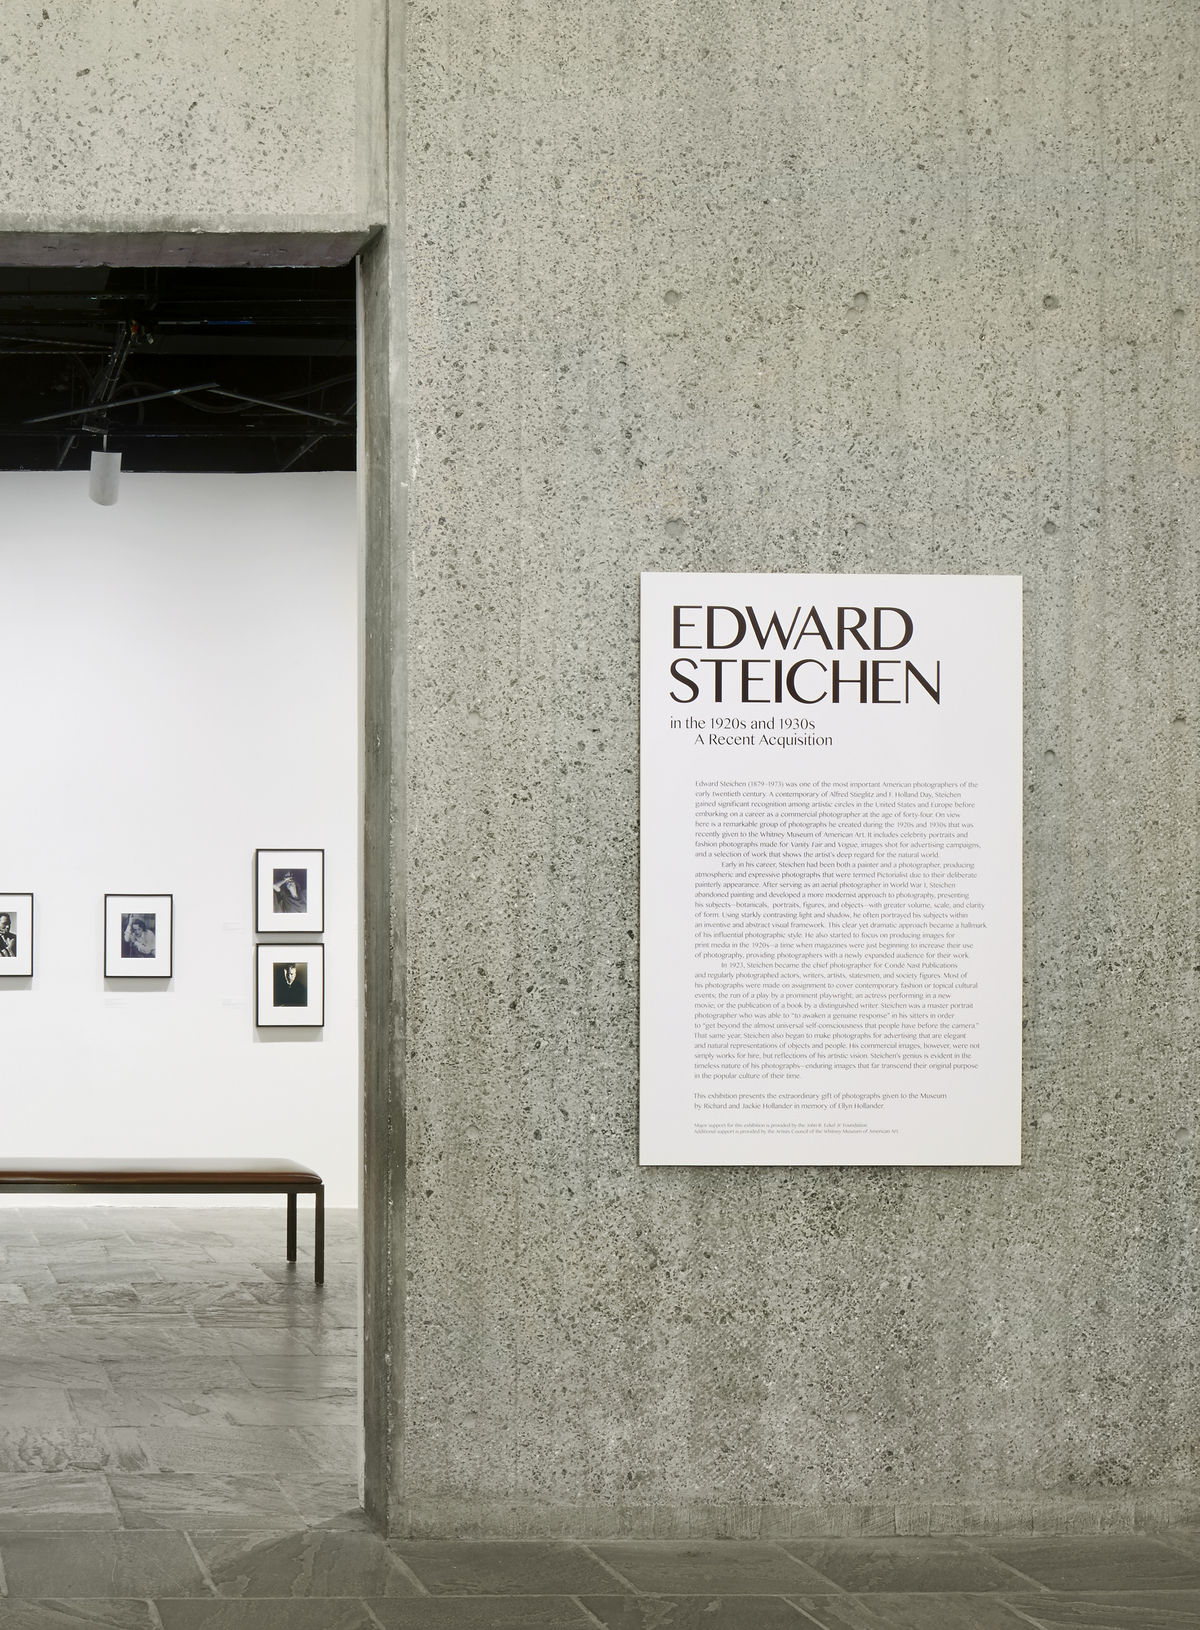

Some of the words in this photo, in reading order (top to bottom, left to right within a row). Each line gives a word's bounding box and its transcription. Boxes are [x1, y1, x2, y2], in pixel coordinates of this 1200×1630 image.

[673, 605, 914, 650] EDWARD
[669, 658, 940, 704] STEICHEN
[670, 716, 681, 729] in
[685, 716, 706, 729] the
[710, 717, 746, 730] 1920s
[750, 716, 775, 730] and
[779, 718, 816, 730] 1930s
[694, 734, 705, 745] A
[709, 734, 755, 746] Recent
[758, 734, 833, 748] Acquisition
[849, 781, 880, 789] important
[912, 781, 958, 790] photographers
[695, 801, 716, 809] gained
[718, 801, 749, 809] significant
[750, 801, 786, 809] recognition
[930, 801, 952, 810] Europe
[695, 831, 720, 839] recently
[722, 831, 738, 840] given
[760, 831, 785, 840] Whitney
[900, 831, 927, 840] celebrity
[928, 832, 955, 840] portraits
[718, 841, 758, 850] photographs
[789, 841, 810, 850] Vanity
[837, 841, 859, 850] Vogue,
[860, 842, 883, 850] images
[909, 841, 944, 850] advertising
[695, 871, 733, 880] atmospheric
[748, 872, 780, 880] expressive
[782, 871, 820, 880] photographs
[722, 912, 739, 920] Using
[741, 912, 761, 920] starkly
[762, 912, 797, 920] contrasting
[798, 912, 812, 920] light
[880, 912, 911, 920] portrayed
[923, 912, 948, 920] subjects
[746, 952, 775, 960] providing
[776, 952, 822, 960] photographers
[844, 952, 862, 960] newly
[864, 952, 894, 960] expanded
[708, 972, 734, 980] regularly
[736, 972, 778, 980] photographed
[895, 973, 917, 981] society
[730, 1043, 777, 1051] representations
[788, 1043, 810, 1051] objects
[738, 1093, 765, 1101] presents
[778, 1093, 819, 1101] extraordinary
[821, 1093, 831, 1101] gift
[842, 1093, 880, 1101] photographs
[882, 1093, 899, 1101] given
